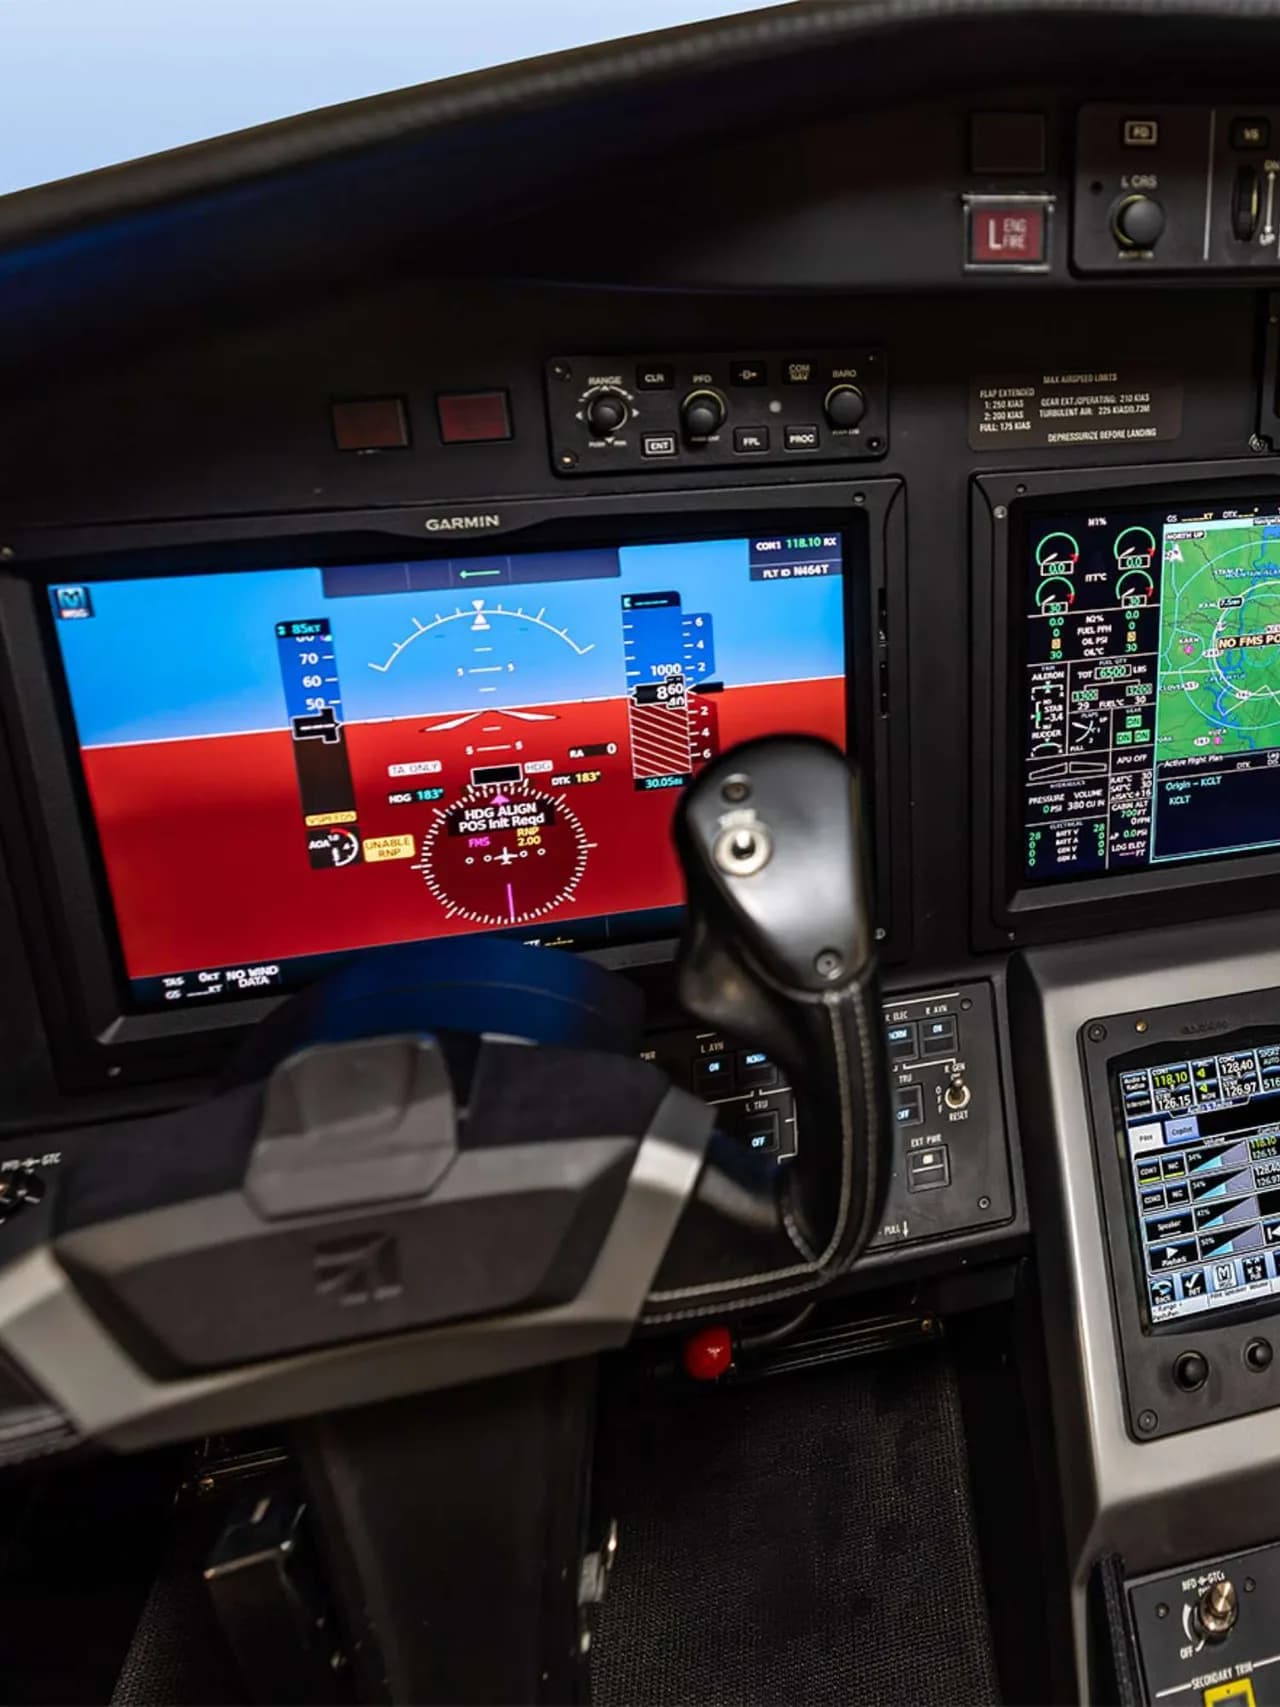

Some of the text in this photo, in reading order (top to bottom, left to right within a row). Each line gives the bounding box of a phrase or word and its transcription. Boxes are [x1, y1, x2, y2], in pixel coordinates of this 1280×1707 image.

[1121, 175, 1157, 188] L CRS
[988, 218, 1027, 250] L ENG
[1002, 234, 1025, 249] FIRE
[645, 373, 664, 383] CLR
[692, 374, 712, 384] PFD
[832, 370, 857, 379] BARO
[1043, 373, 1118, 384] MAX AIRSPEED LIMITS
[588, 376, 622, 385] RANGE
[980, 388, 1035, 399] FLAP EXTENDED
[1000, 423, 1013, 431] 175
[1014, 421, 1031, 430] KIAS
[789, 433, 814, 444] PROC
[1100, 430, 1125, 439] BEFORE
[1126, 428, 1157, 438] LANDING
[650, 441, 669, 451] ENT
[743, 436, 760, 447] FPL
[425, 514, 500, 531] GARMIN
[756, 540, 782, 551] COM1
[786, 537, 821, 548] 118.10
[762, 564, 830, 578] FLT ID N464T
[1218, 637, 1237, 649] NO
[1239, 635, 1264, 647] FMS
[300, 653, 319, 665] 70
[651, 663, 682, 677] 1000
[303, 675, 322, 687] 60
[1032, 671, 1065, 681] AILERON
[306, 698, 326, 710] 50
[1043, 704, 1064, 714] STAB
[569, 743, 617, 759] RA 0
[1117, 754, 1148, 765] APU OFF
[1164, 754, 1224, 768] Active Flight Plan
[1165, 775, 1222, 792] Origin KCLT
[389, 793, 412, 804] HDG
[1028, 794, 1065, 805] PRESSURE
[1073, 789, 1103, 799] VOLUME
[1169, 794, 1191, 805] KCLT
[464, 802, 537, 821] HDG ALIGN
[1111, 801, 1148, 812] CABIN ALT
[459, 813, 545, 833] POS Init Reqd
[516, 827, 540, 837] RNP
[365, 838, 411, 850] UNABLE
[468, 835, 542, 848] FMS 2.00
[378, 848, 402, 858] RNP
[162, 977, 186, 988] TAS
[225, 970, 246, 981] NO
[248, 965, 279, 977] WIND
[238, 976, 270, 988] DATA
[932, 1024, 944, 1033] ON
[708, 1062, 721, 1072] ON
[1154, 1058, 1254, 1087] 118.10 128.40
[1157, 1094, 1192, 1111] 126.15
[1224, 1081, 1257, 1098] 126.97
[897, 1109, 910, 1120] OFF
[949, 1111, 969, 1121] RESET
[751, 1136, 766, 1148] OFF
[911, 1135, 942, 1147] EXT PWR
[1250, 1137, 1277, 1148] 118.10
[1252, 1148, 1278, 1160] 126.15
[884, 1224, 900, 1234] PULL
[1180, 1645, 1194, 1660] OFF
[1190, 1661, 1253, 1690] SECONDARY TRIM
